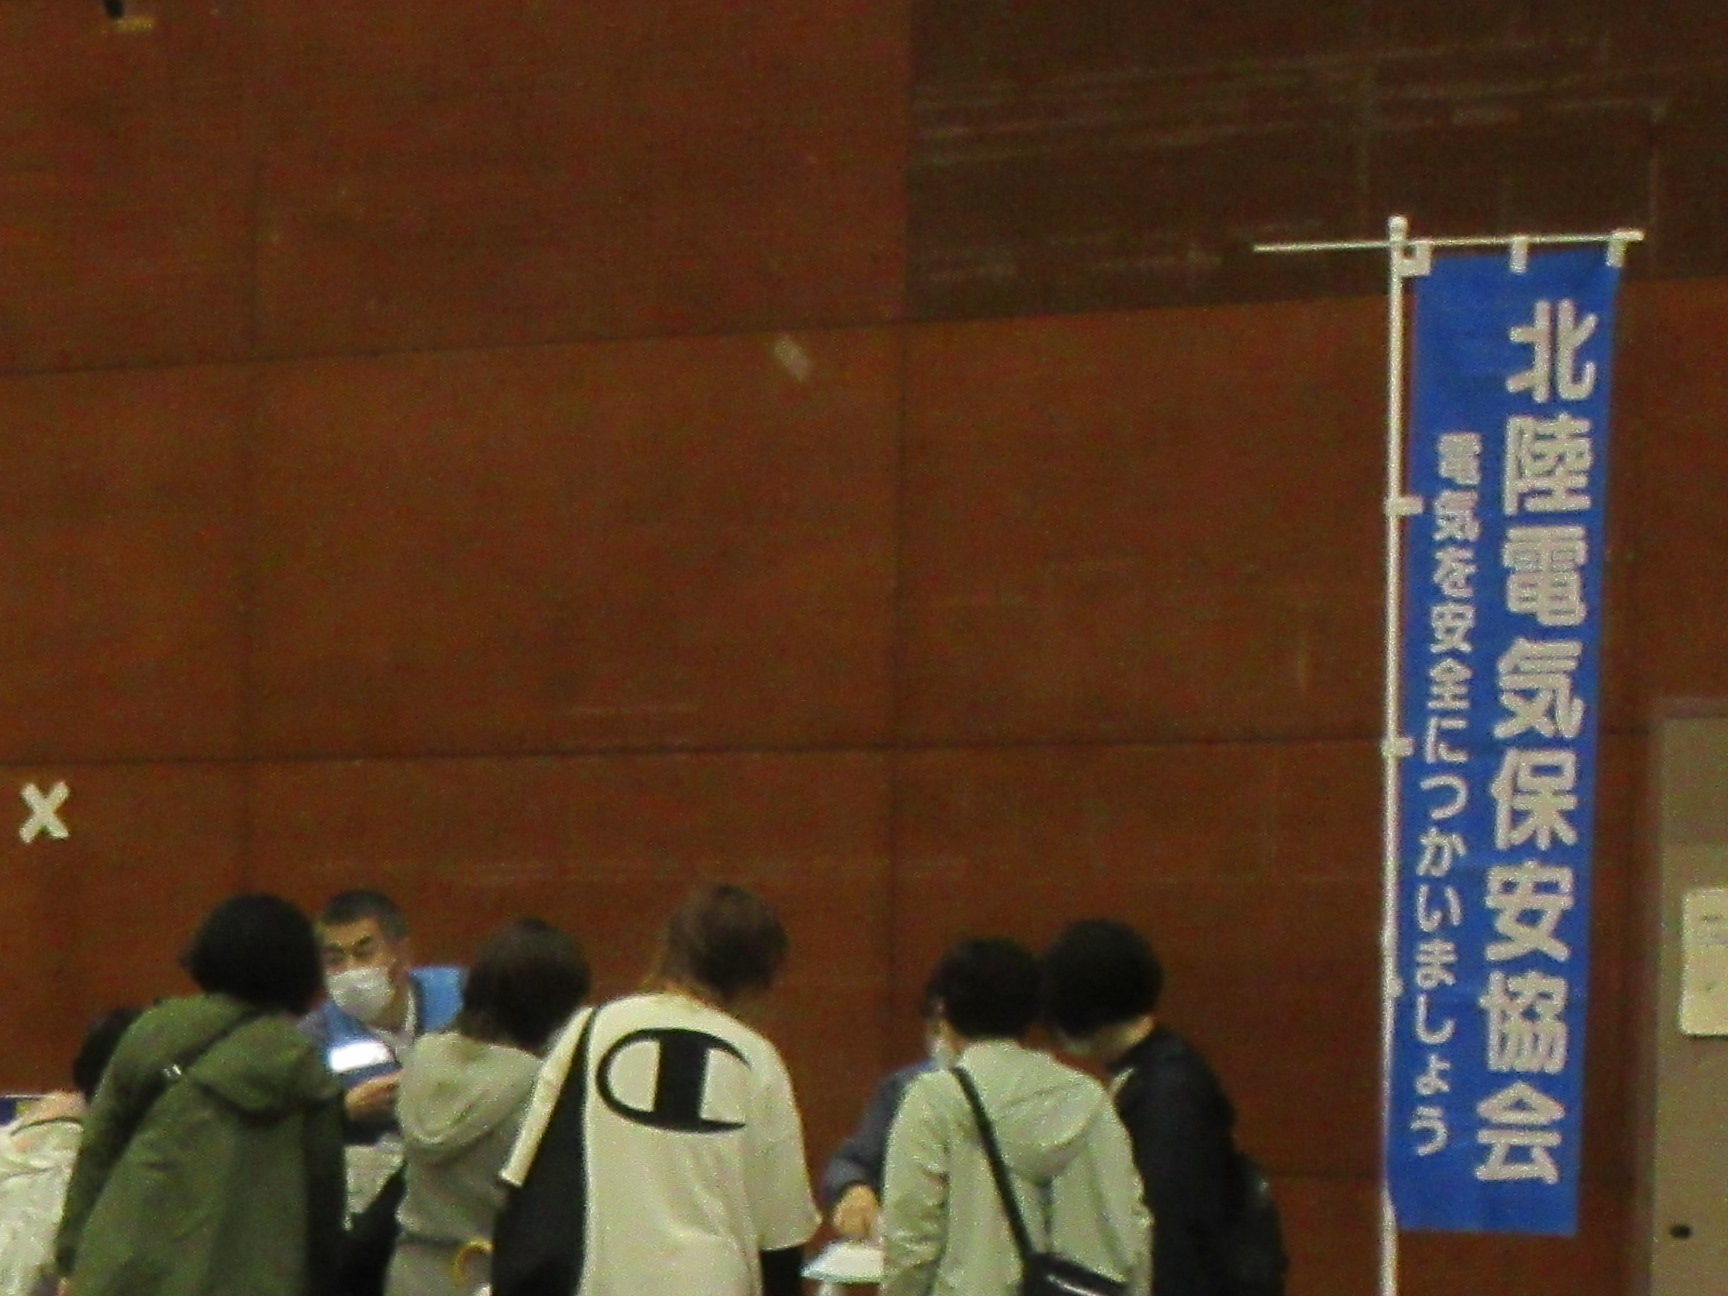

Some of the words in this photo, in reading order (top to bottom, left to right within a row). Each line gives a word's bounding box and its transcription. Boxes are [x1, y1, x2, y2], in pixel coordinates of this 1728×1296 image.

[1411, 433, 1482, 1156] 電気を安全につかいましょう
[1475, 298, 1598, 1184] 北陸電気保安協会
